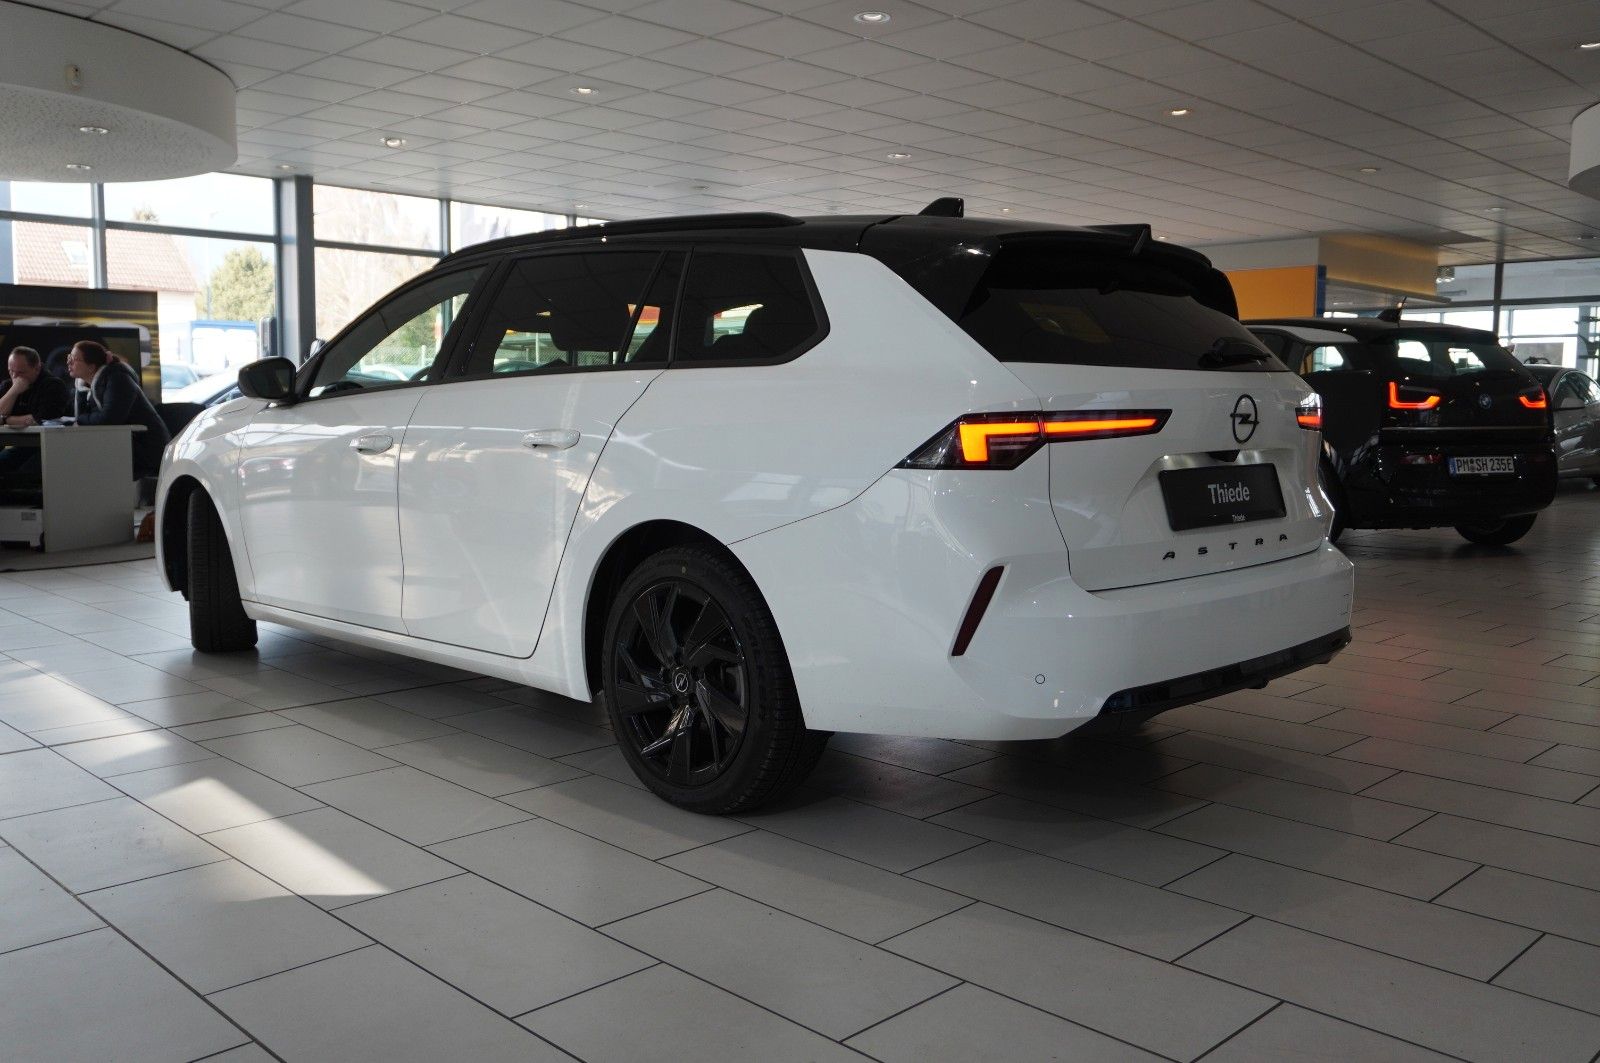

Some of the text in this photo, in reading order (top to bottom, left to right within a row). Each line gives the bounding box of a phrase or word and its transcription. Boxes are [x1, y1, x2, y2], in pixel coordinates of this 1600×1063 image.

[1475, 458, 1489, 472] SH
[1489, 458, 1514, 472] 235E
[1207, 482, 1250, 504] Thiede
[1163, 533, 1288, 560] ASTRA
